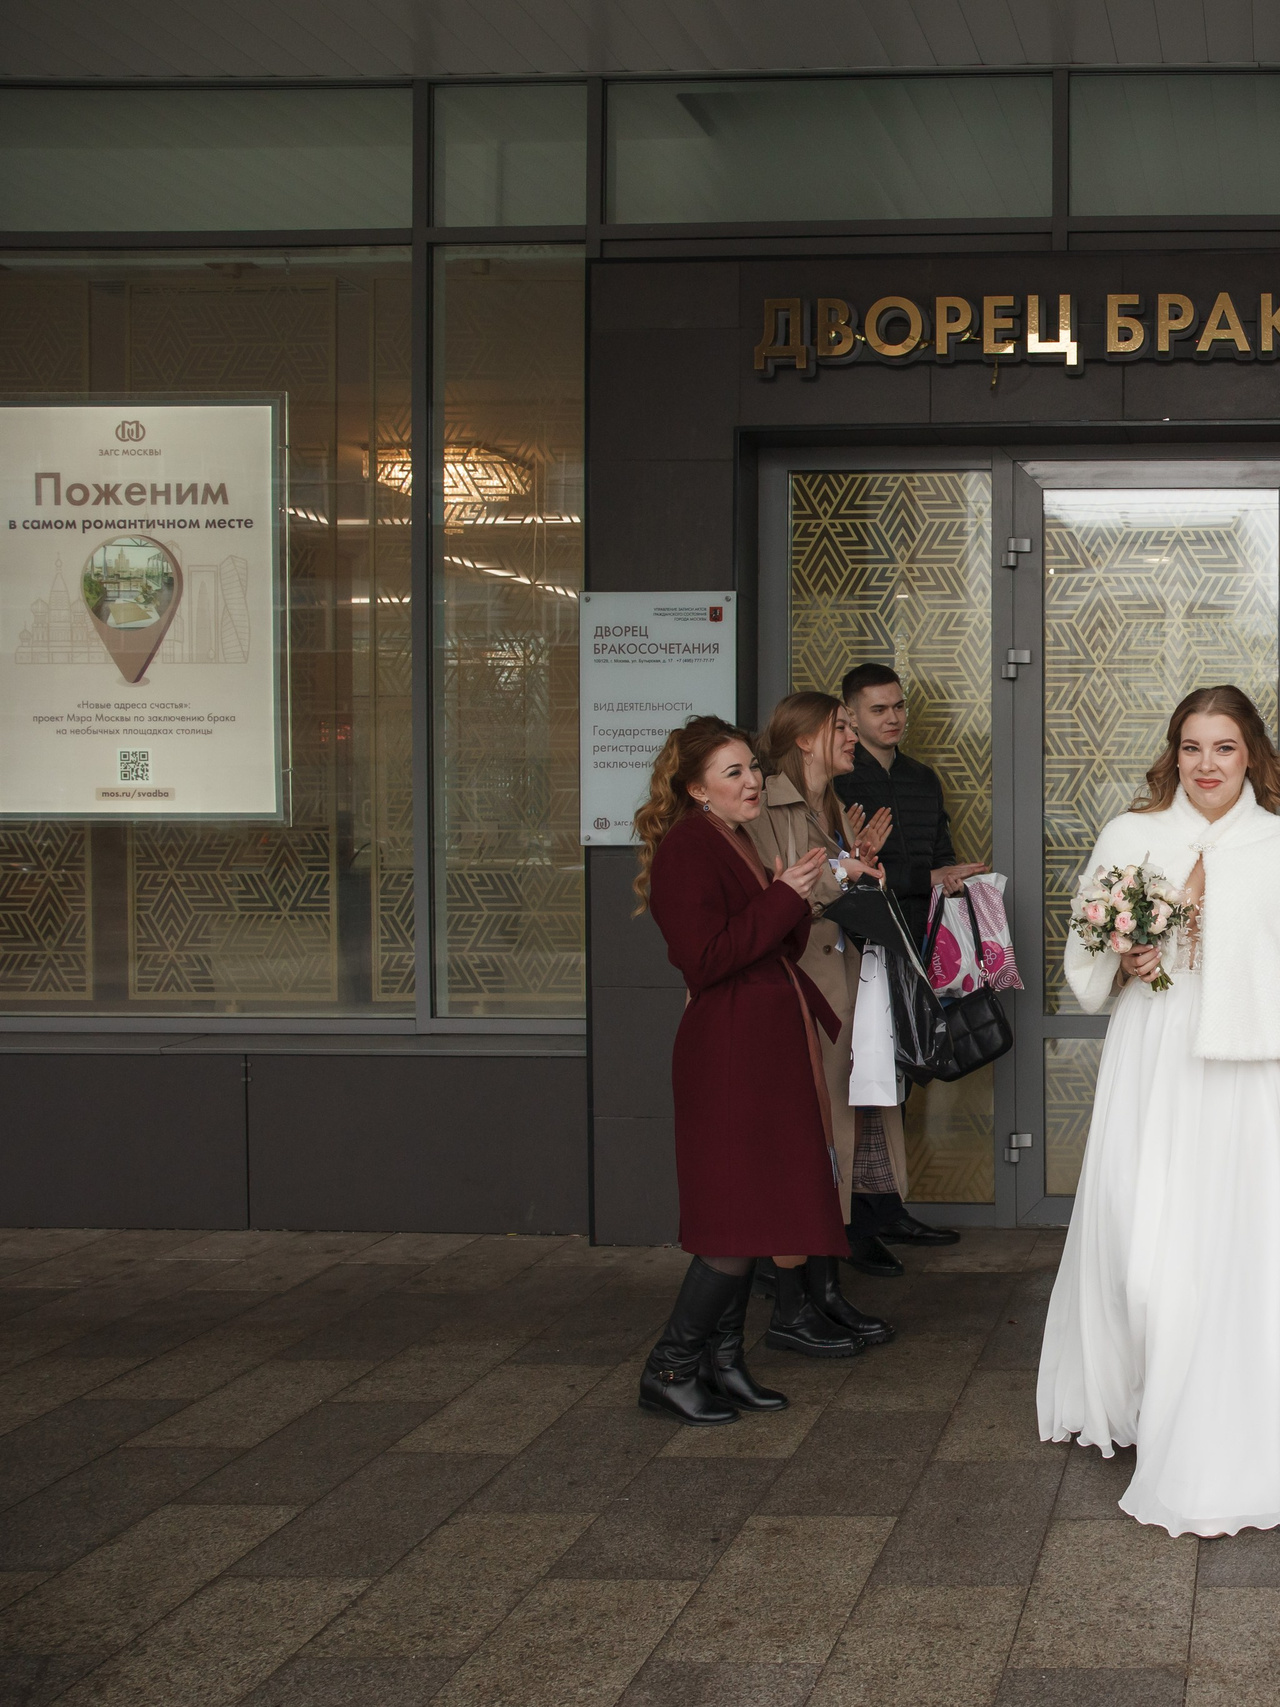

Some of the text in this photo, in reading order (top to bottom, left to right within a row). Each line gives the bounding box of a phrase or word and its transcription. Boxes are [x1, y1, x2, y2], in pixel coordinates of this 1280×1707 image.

[754, 294, 1078, 370] ДВОРЕЦ
[98, 448, 162, 457] ЗАГС МОСКВЫ
[34, 472, 229, 506] Поженим
[8, 517, 254, 533] в самом романтичном месте
[594, 626, 649, 639] ДВОРЕЦ
[593, 642, 720, 655] БРАКОСОЧЕТАНИЯ
[76, 700, 192, 713] «Новые адреса счастья»:
[593, 702, 693, 713] ВИД ДЕЯТЕЛЬНОСТИ
[32, 715, 64, 724] проект
[67, 714, 93, 723] Мэра
[95, 714, 131, 722] Москвы
[147, 715, 205, 723] заключению
[207, 714, 236, 723] брака
[70, 727, 120, 735] необычных
[122, 728, 173, 736] площадках
[176, 728, 213, 736] столицы
[592, 725, 673, 739] Государствен
[101, 789, 169, 799] mos.ru/svadba
